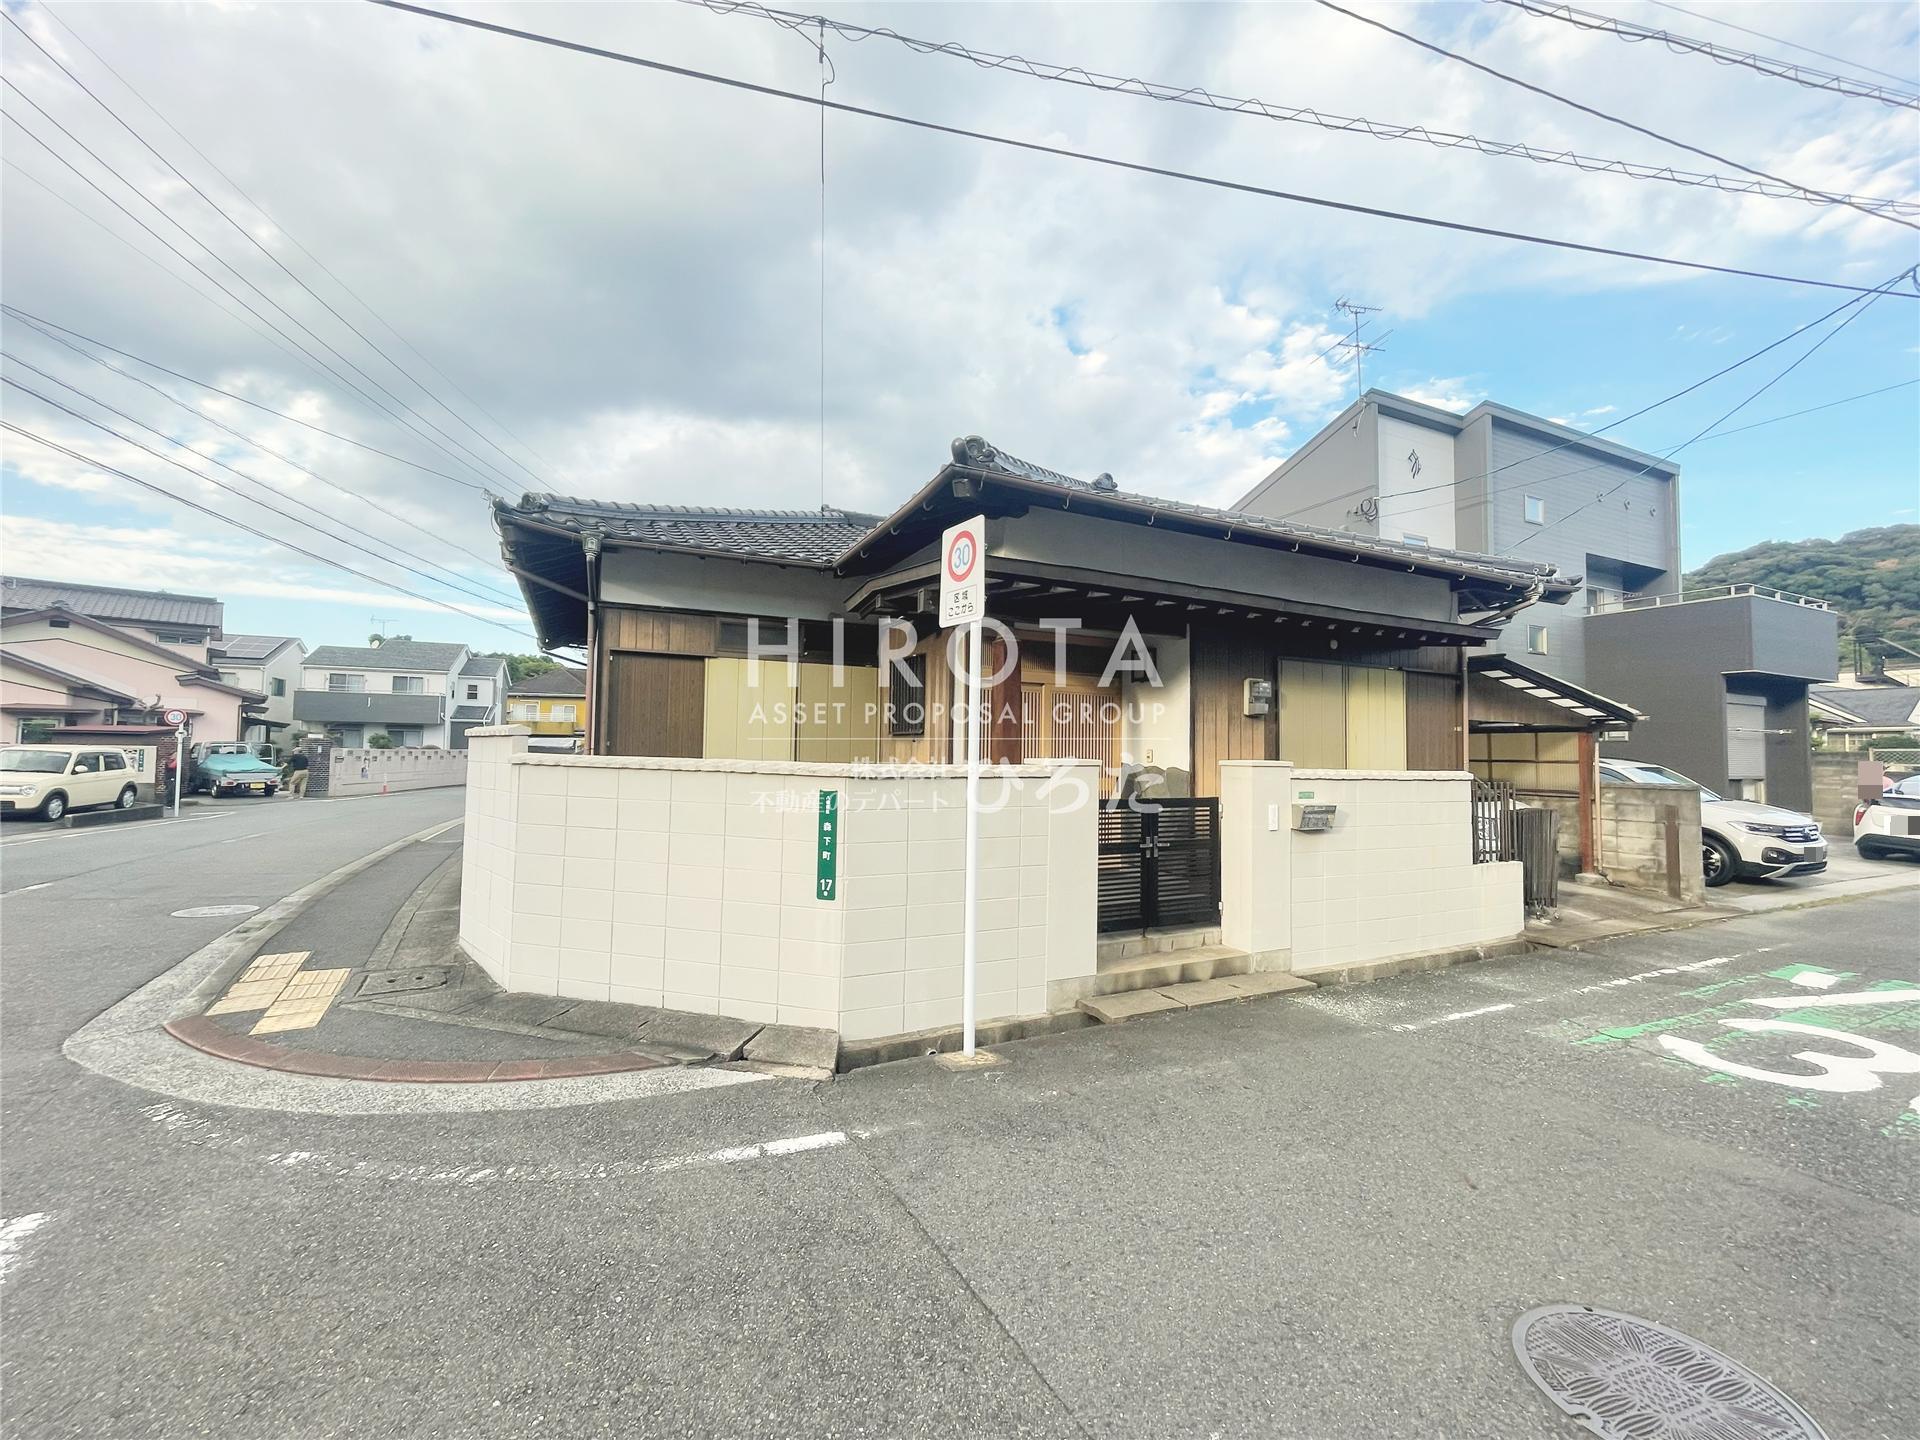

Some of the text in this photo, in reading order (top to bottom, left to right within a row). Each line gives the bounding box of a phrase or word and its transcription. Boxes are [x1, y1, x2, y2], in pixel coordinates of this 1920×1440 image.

[953, 543, 970, 569] 30
[948, 602, 974, 617] ここから
[170, 712, 182, 721] 30
[822, 821, 832, 861] 森下町
[820, 879, 832, 891] 17
